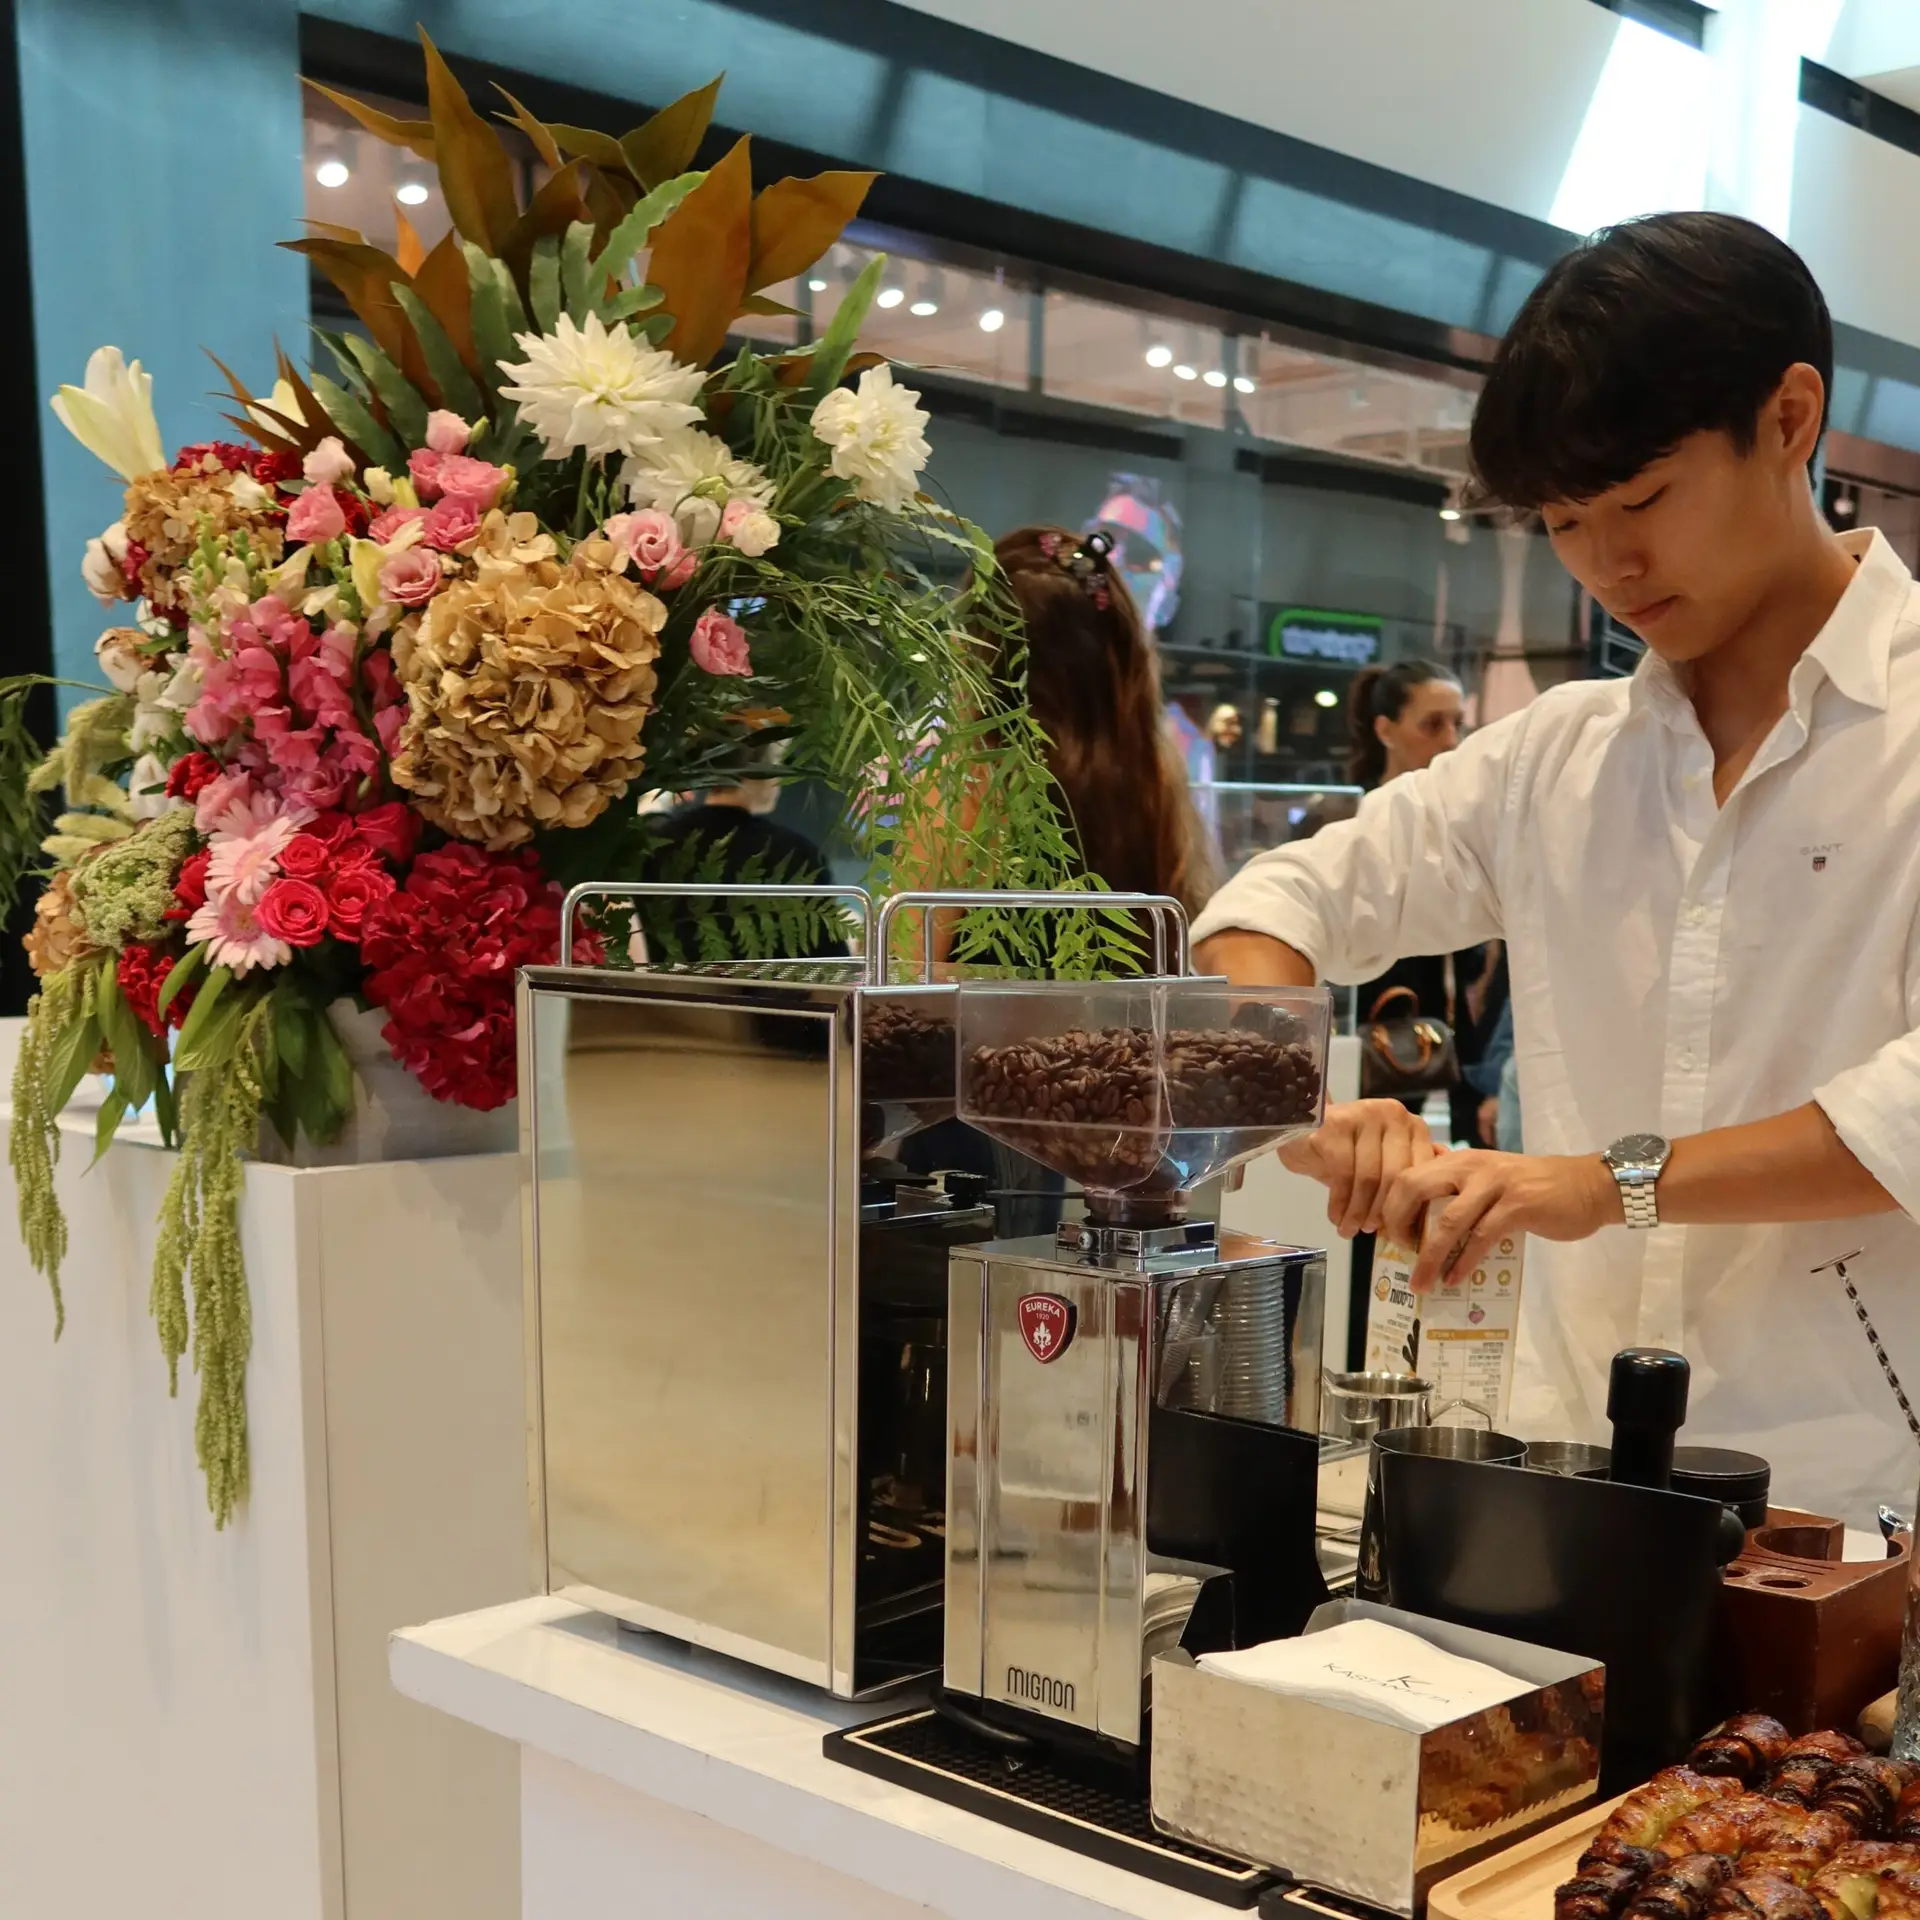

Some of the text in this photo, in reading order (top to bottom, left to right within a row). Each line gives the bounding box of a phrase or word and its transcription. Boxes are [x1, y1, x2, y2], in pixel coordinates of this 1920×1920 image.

[1799, 842, 1845, 856] GANT
[1025, 1301, 1061, 1318] EUREKA
[1036, 1312, 1050, 1320] 1920
